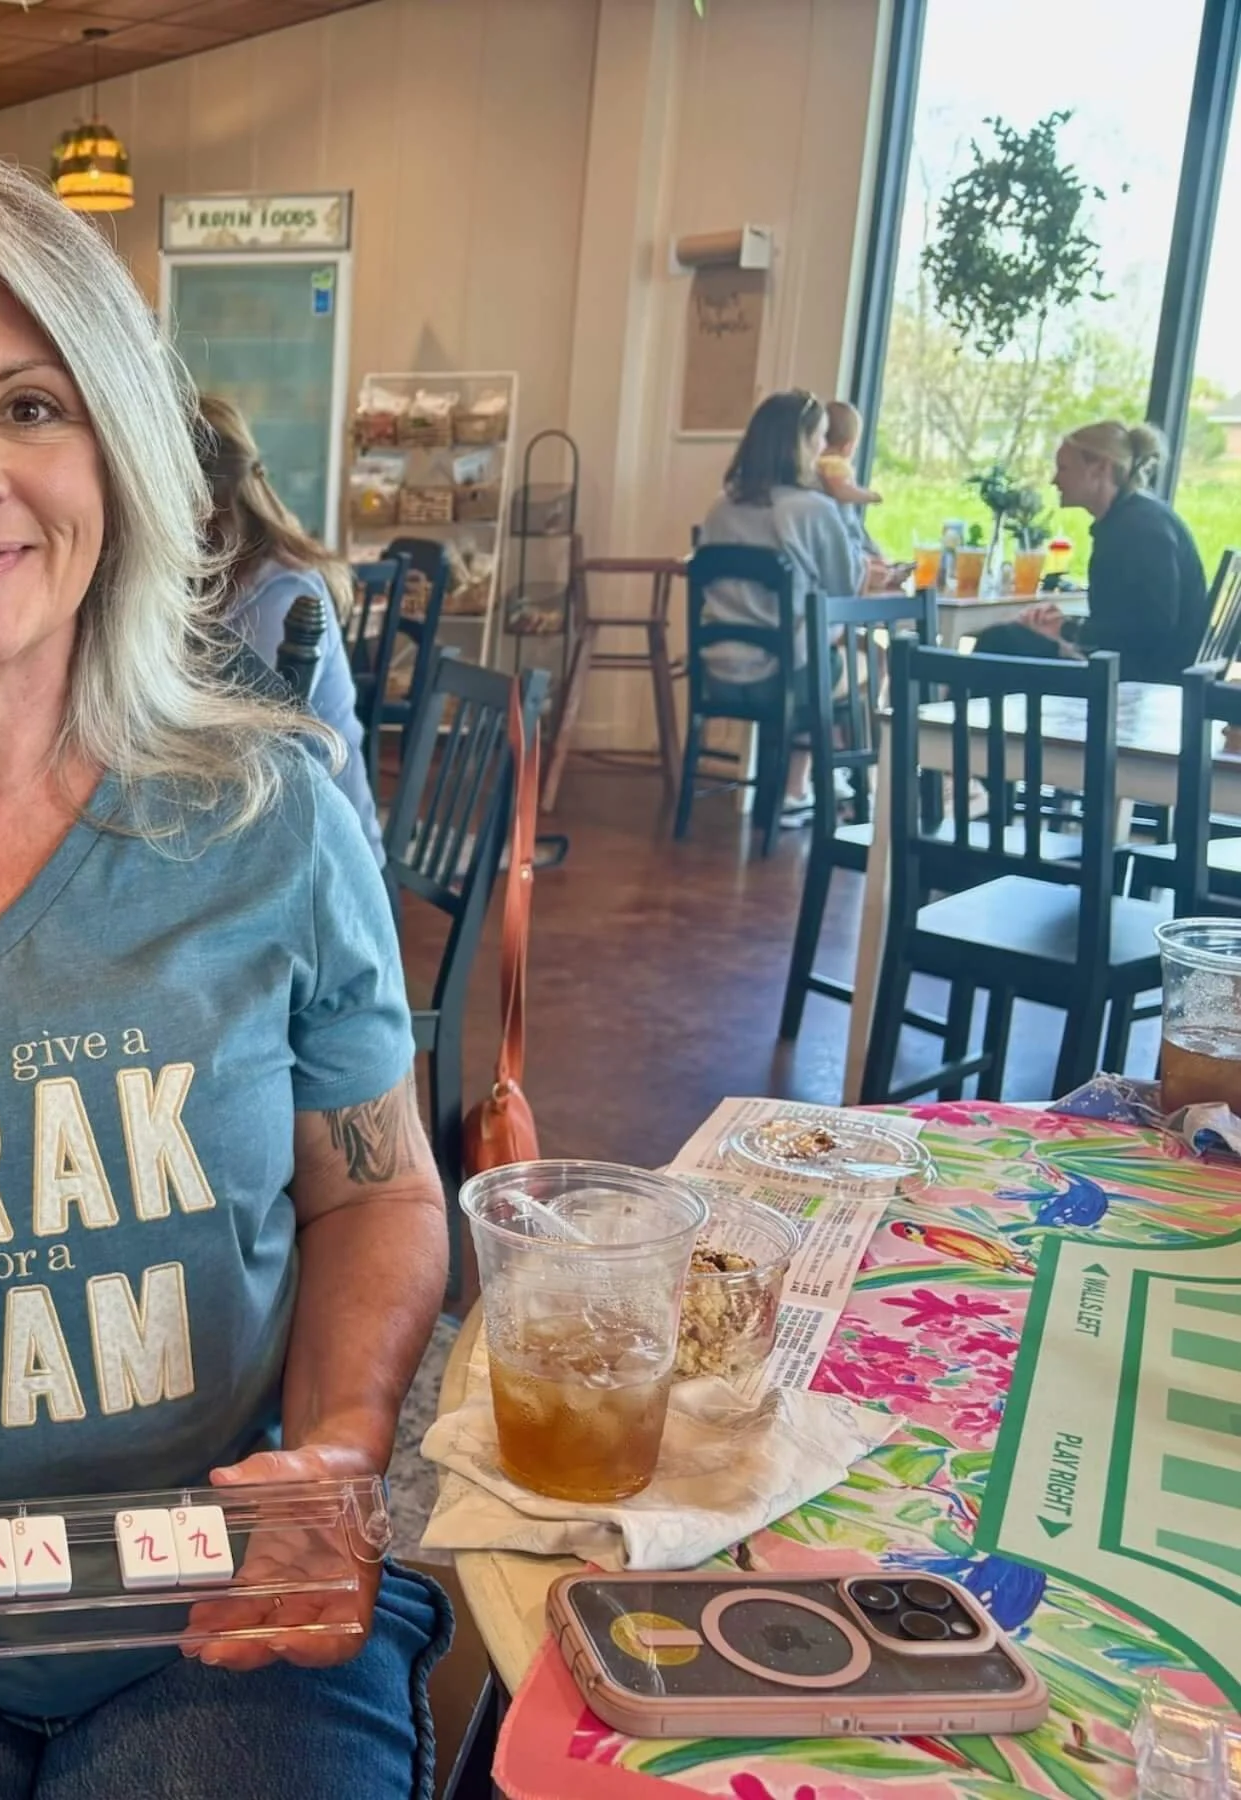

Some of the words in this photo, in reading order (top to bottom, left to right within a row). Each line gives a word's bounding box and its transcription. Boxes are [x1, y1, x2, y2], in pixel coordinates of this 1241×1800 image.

[11, 1030, 108, 1082] give
[122, 1028, 150, 1055] a
[47, 1243, 76, 1272] a
[1079, 1277, 1108, 1312] WALLS
[1074, 1310, 1103, 1338] LEFT
[1052, 1431, 1083, 1471] PLAY
[1044, 1467, 1078, 1517] RIGHT
[15, 1520, 26, 1535] 8
[122, 1513, 134, 1529] 9
[175, 1511, 187, 1526] 9
[24, 1540, 62, 1567] 八
[134, 1528, 169, 1562] 九
[188, 1526, 223, 1559] 九
